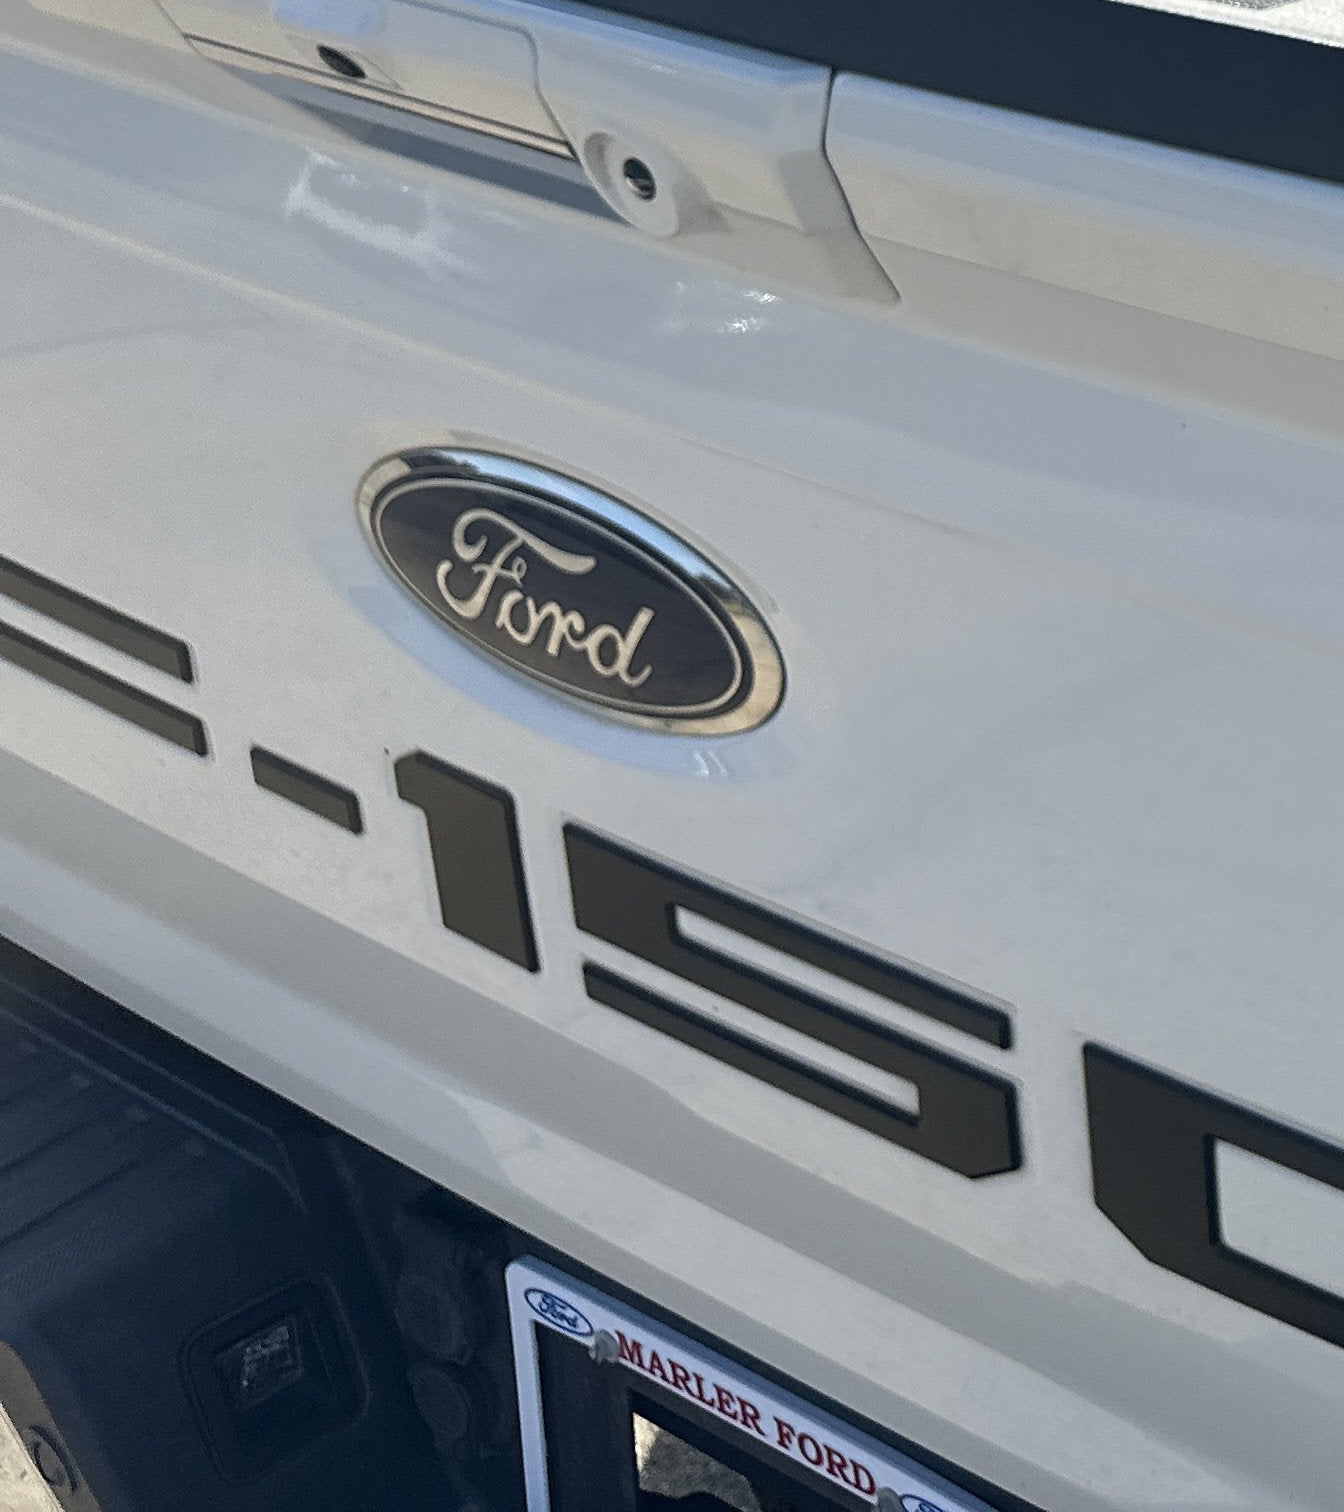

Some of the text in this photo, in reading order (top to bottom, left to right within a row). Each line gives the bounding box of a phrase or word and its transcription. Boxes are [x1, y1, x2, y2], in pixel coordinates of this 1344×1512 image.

[435, 507, 655, 686] Ford
[537, 1292, 579, 1328] Ford
[614, 1330, 877, 1496] MARLER FORD
